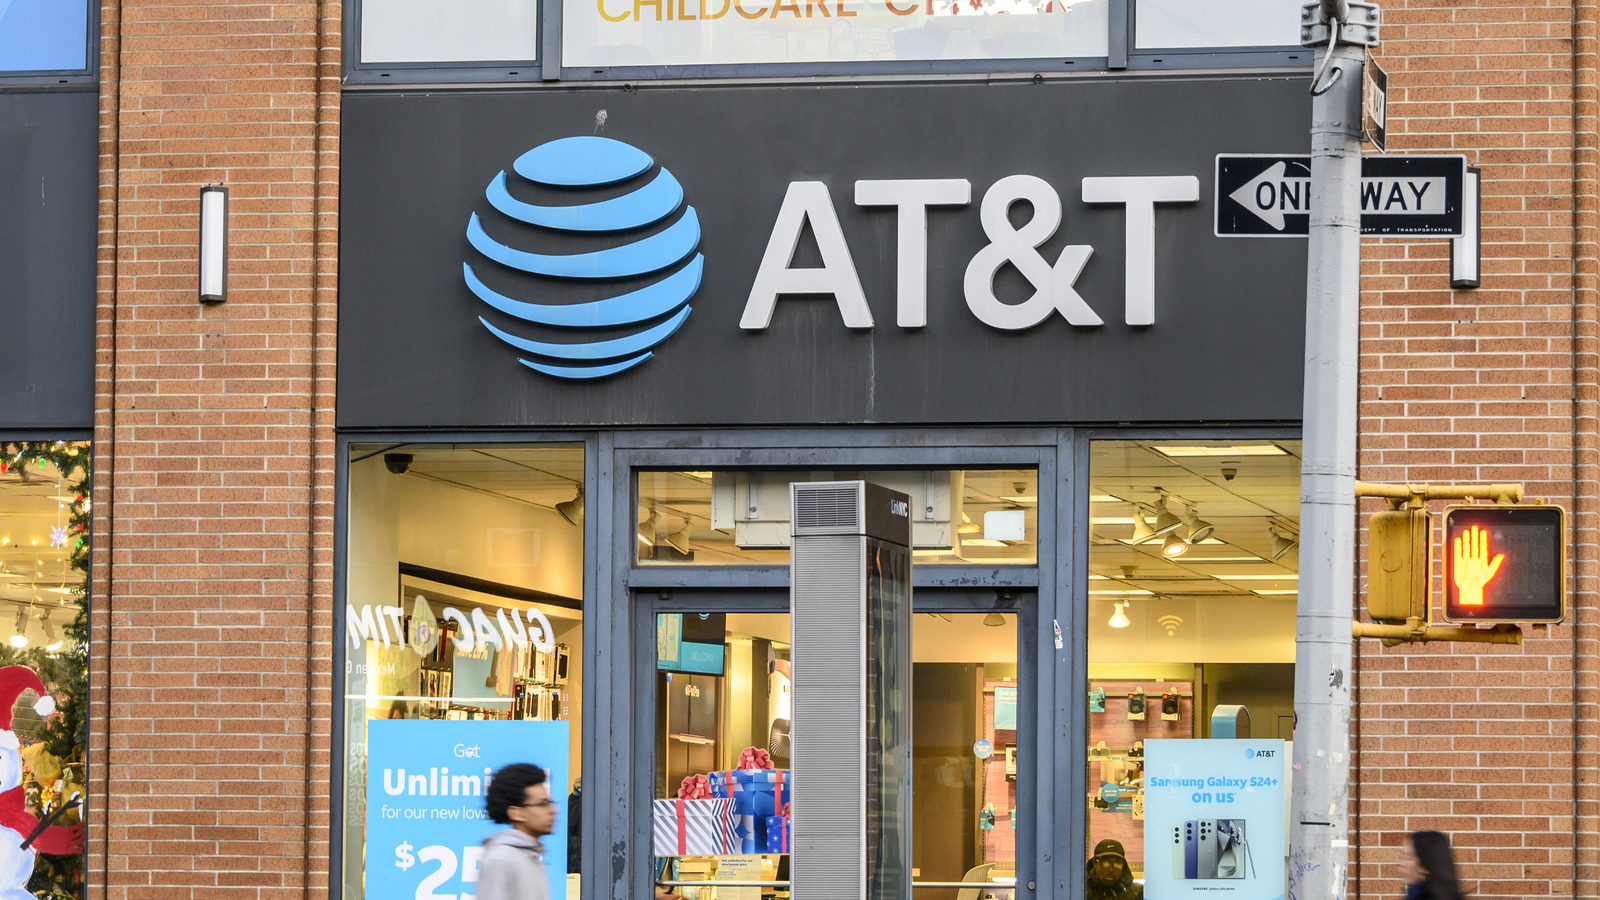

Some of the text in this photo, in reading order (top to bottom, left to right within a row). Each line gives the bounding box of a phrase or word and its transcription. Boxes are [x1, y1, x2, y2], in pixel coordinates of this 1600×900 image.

[597, 0, 857, 22] CHILDCARE
[1360, 181, 1431, 211] WAY
[739, 174, 1200, 330] AT&T
[690, 651, 715, 663] WELCOME
[453, 743, 481, 758] Get
[1256, 750, 1276, 758] AT&T
[1150, 776, 1278, 790] Samsung Galaxy S24+
[1191, 792, 1212, 803] on
[381, 804, 402, 819] for
[404, 808, 428, 819] our
[430, 808, 460, 819] new
